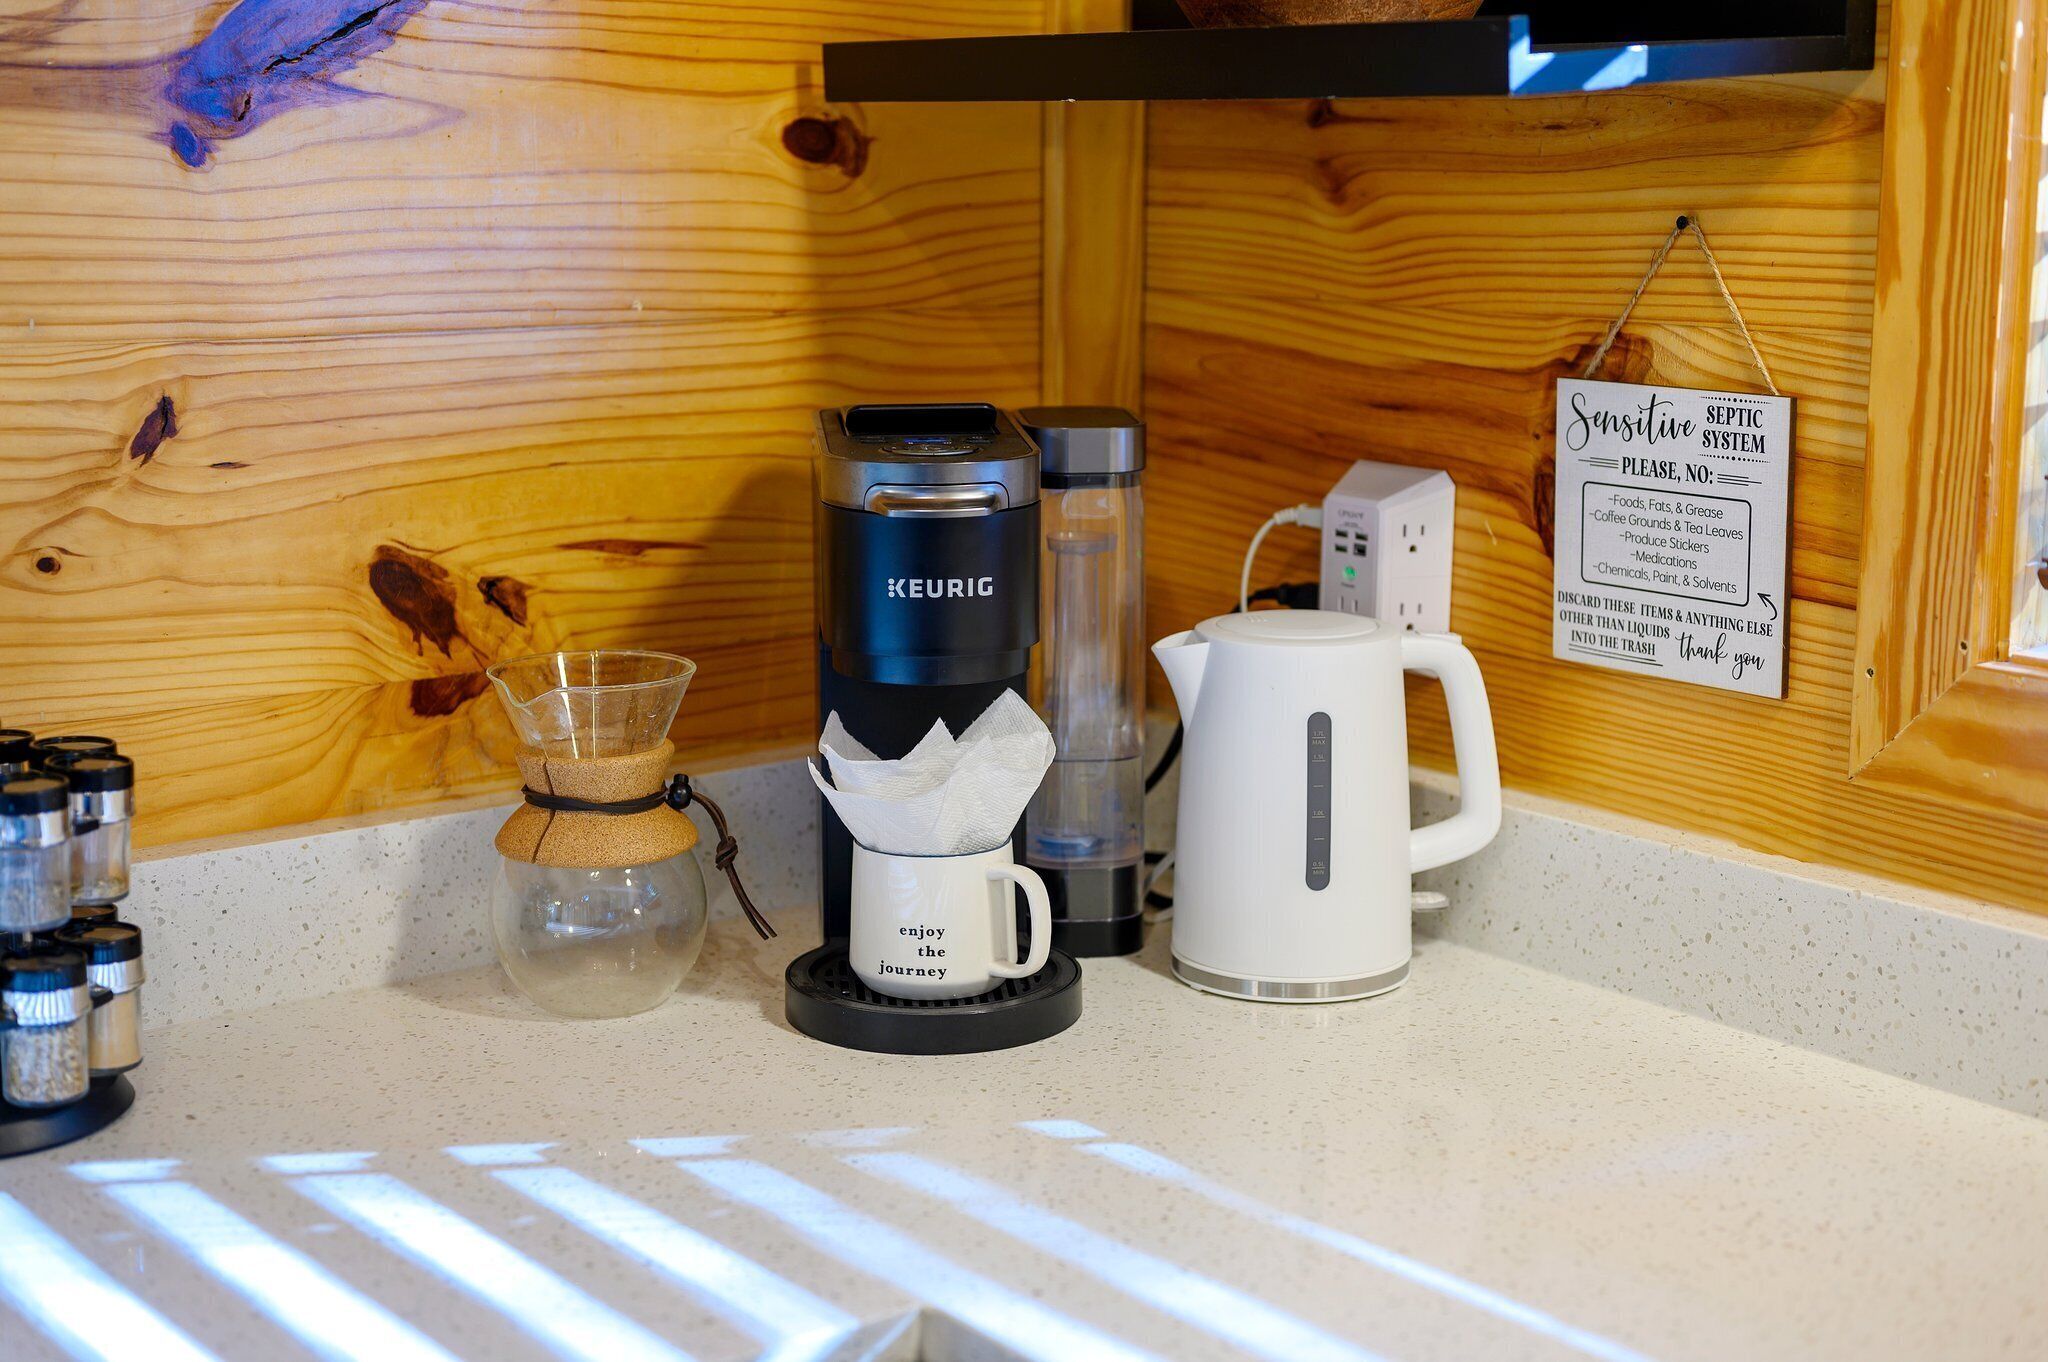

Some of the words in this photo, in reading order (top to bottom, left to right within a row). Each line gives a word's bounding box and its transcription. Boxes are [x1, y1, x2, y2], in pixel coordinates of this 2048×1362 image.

[1566, 391, 1697, 451] Sensitive
[1706, 405, 1763, 428] SEPTIC
[1702, 429, 1766, 454] SYSTEM
[1622, 456, 1681, 483] PLEASE,
[1686, 464, 1714, 485] NO:
[1649, 498, 1673, 514] Fats,
[1676, 502, 1683, 514] &
[1686, 503, 1723, 519] Grease
[1628, 514, 1671, 530] Grounds
[1674, 519, 1682, 531] &
[1684, 521, 1703, 535] Tea
[1706, 524, 1743, 540] Leaves
[1670, 537, 1710, 553] Stickers
[888, 576, 993, 598] KEURIG
[1653, 570, 1680, 586] Paint,
[1683, 574, 1690, 586] &
[1693, 576, 1737, 594] Solvents
[1558, 590, 1601, 609] DISCARD
[1603, 598, 1635, 615] THESE
[1640, 603, 1673, 620] ITEMS
[1676, 610, 1683, 622] &
[1686, 610, 1744, 633] ANYTHING
[1747, 620, 1773, 637] ELSE
[1560, 610, 1594, 626] OTHER
[1597, 617, 1625, 632] THAN
[1627, 620, 1670, 640] LIQUIDS
[1571, 629, 1596, 645] INTO
[1598, 634, 1619, 649] THE
[1622, 637, 1656, 655] TRASH
[1676, 632, 1728, 665] thank
[1732, 648, 1765, 680] you
[900, 925, 945, 940] enjoy
[918, 946, 945, 957] the
[878, 960, 947, 979] journey
